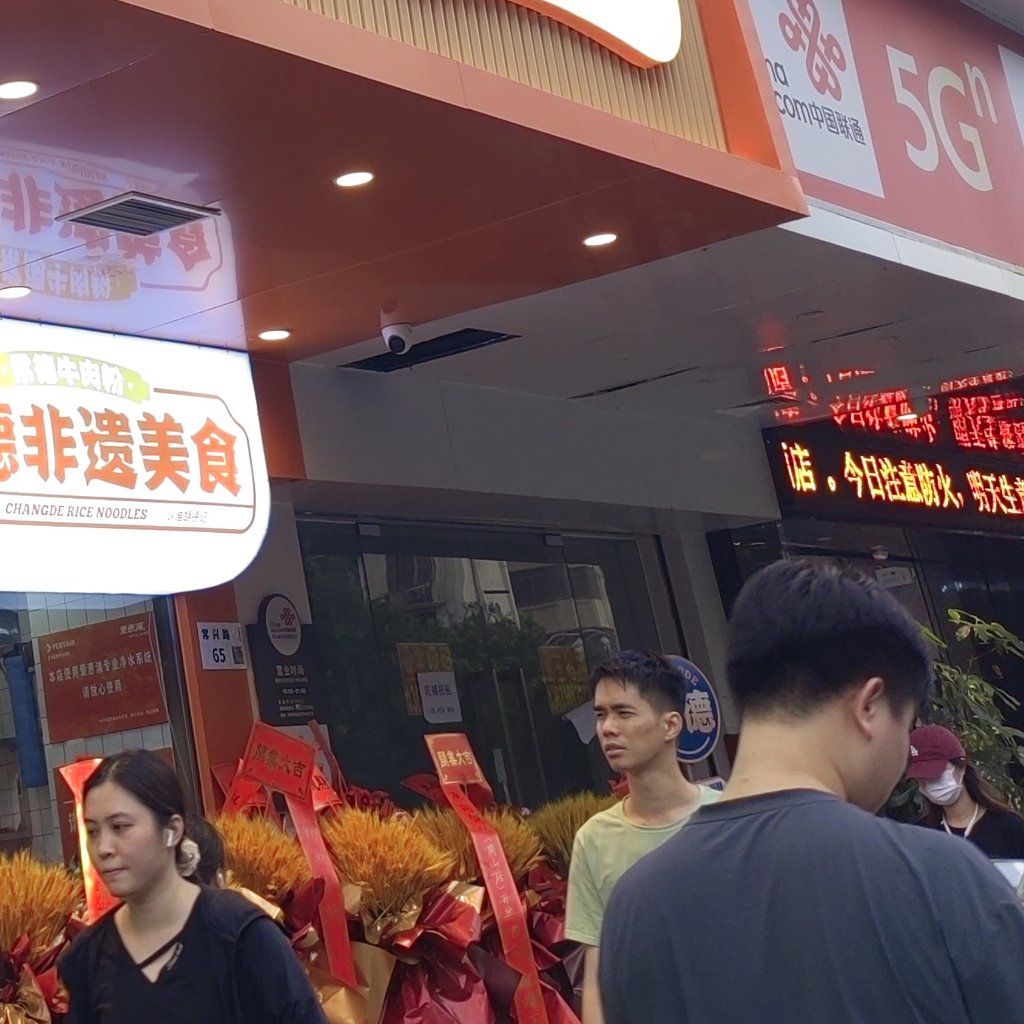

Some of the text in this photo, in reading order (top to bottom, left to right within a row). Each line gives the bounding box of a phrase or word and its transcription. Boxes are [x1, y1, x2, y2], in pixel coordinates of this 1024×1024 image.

[5, 502, 148, 521] CHANGDE RICE NOODLES
[212, 647, 226, 663] 65
